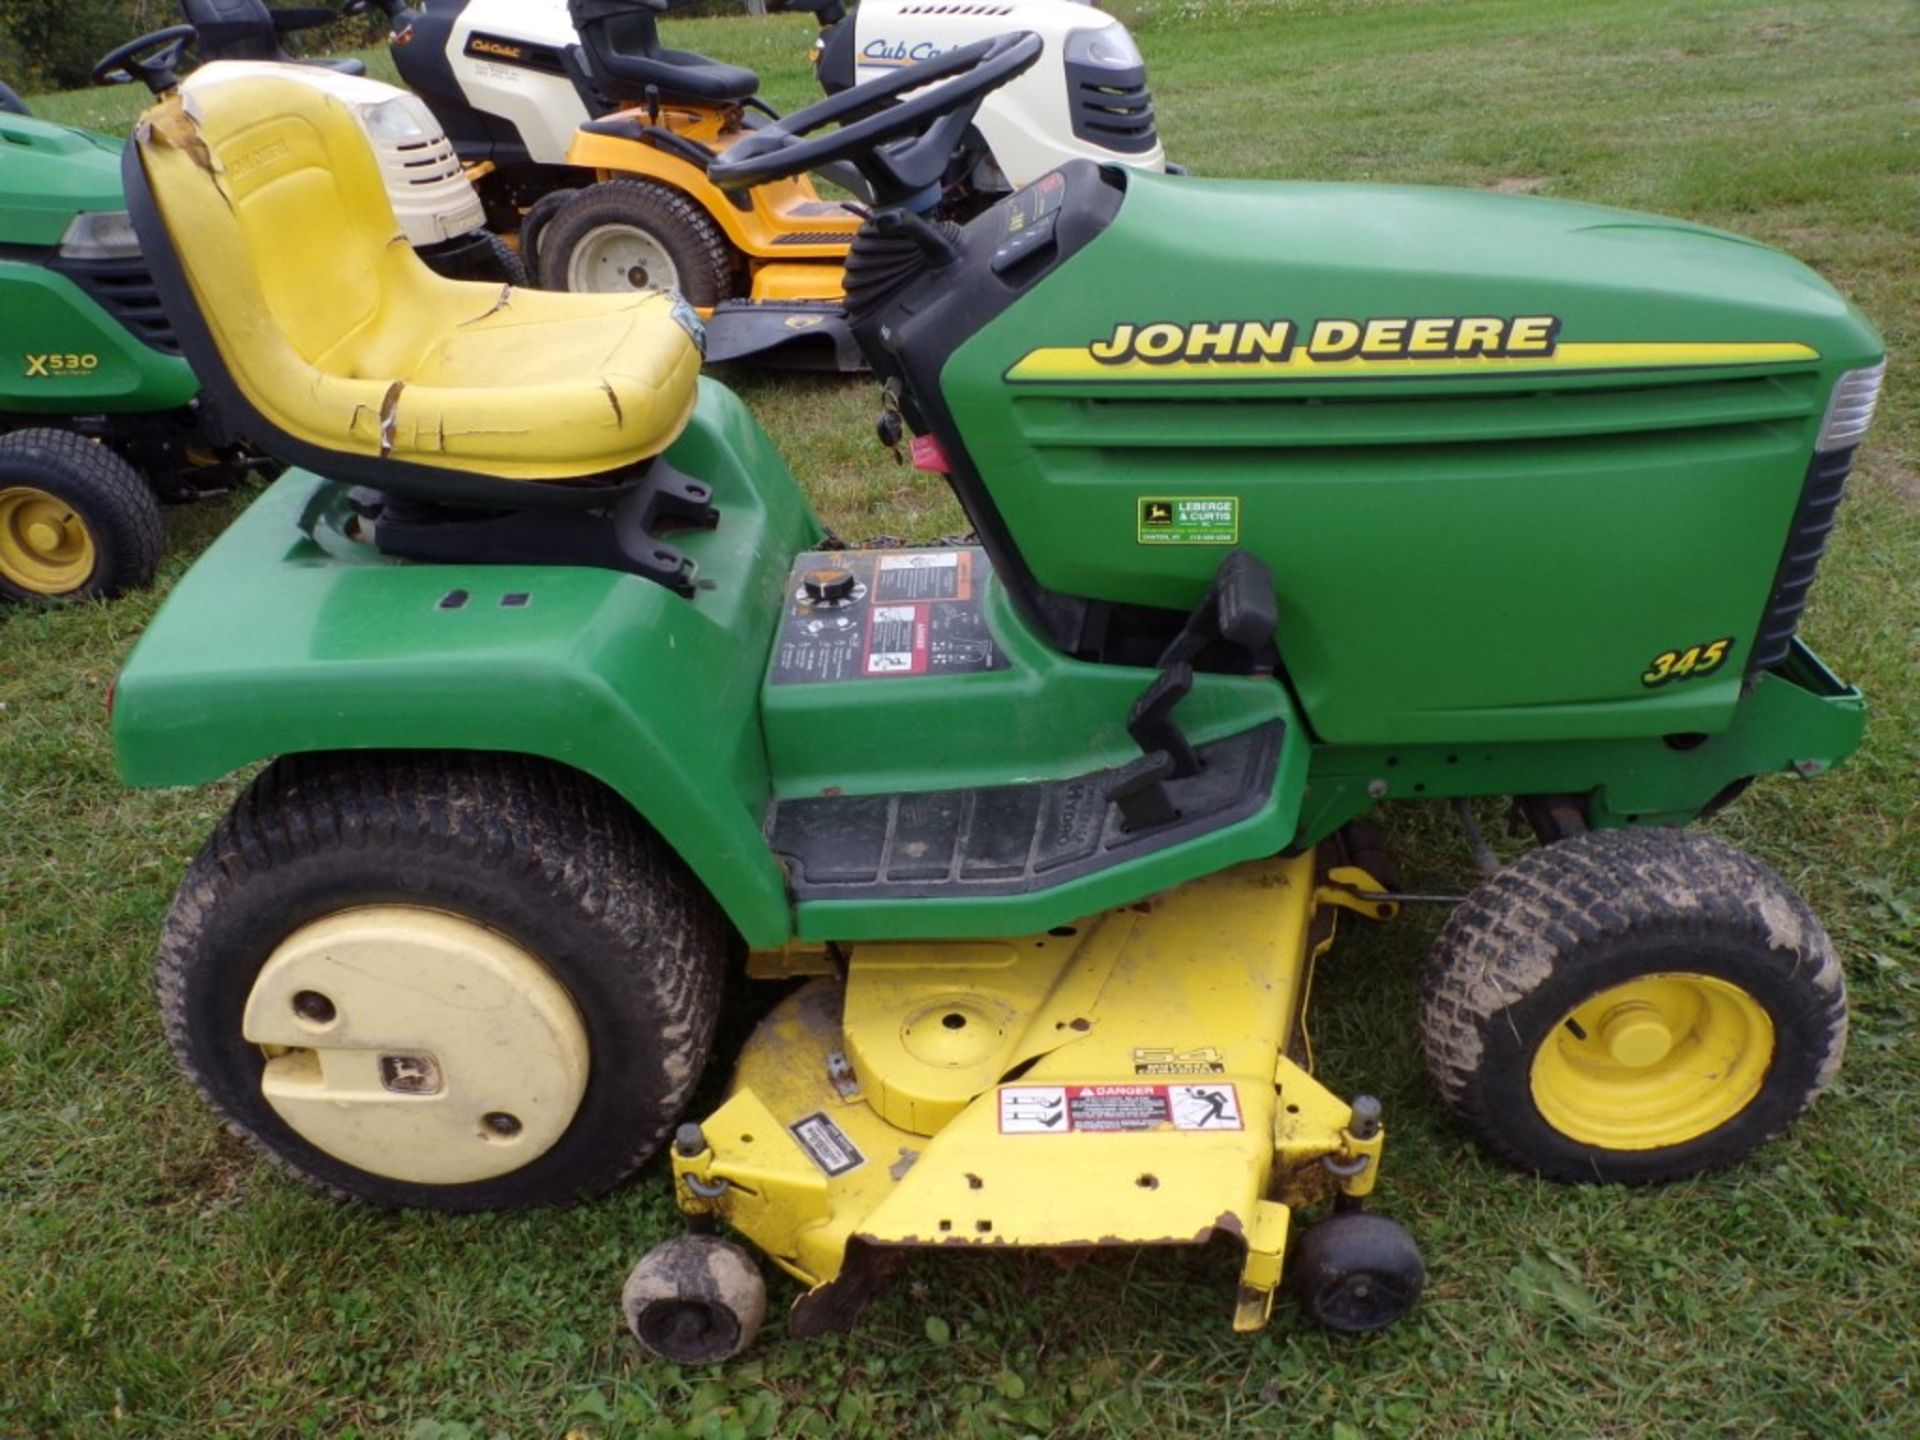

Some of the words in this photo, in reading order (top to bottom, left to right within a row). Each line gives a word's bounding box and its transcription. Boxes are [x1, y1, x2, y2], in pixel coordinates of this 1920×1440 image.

[863, 39, 906, 60] Cub
[1090, 320, 1297, 362] JOHN
[1307, 316, 1560, 361] DEERE
[25, 354, 98, 376] X530
[1178, 502, 1232, 511] LEBERGE
[1190, 512, 1231, 521] CURTIS
[1642, 637, 1733, 686] 345
[1056, 784, 1084, 846] HYDRO
[1133, 1046, 1223, 1063] 54
[1096, 1087, 1154, 1096] DANGER
